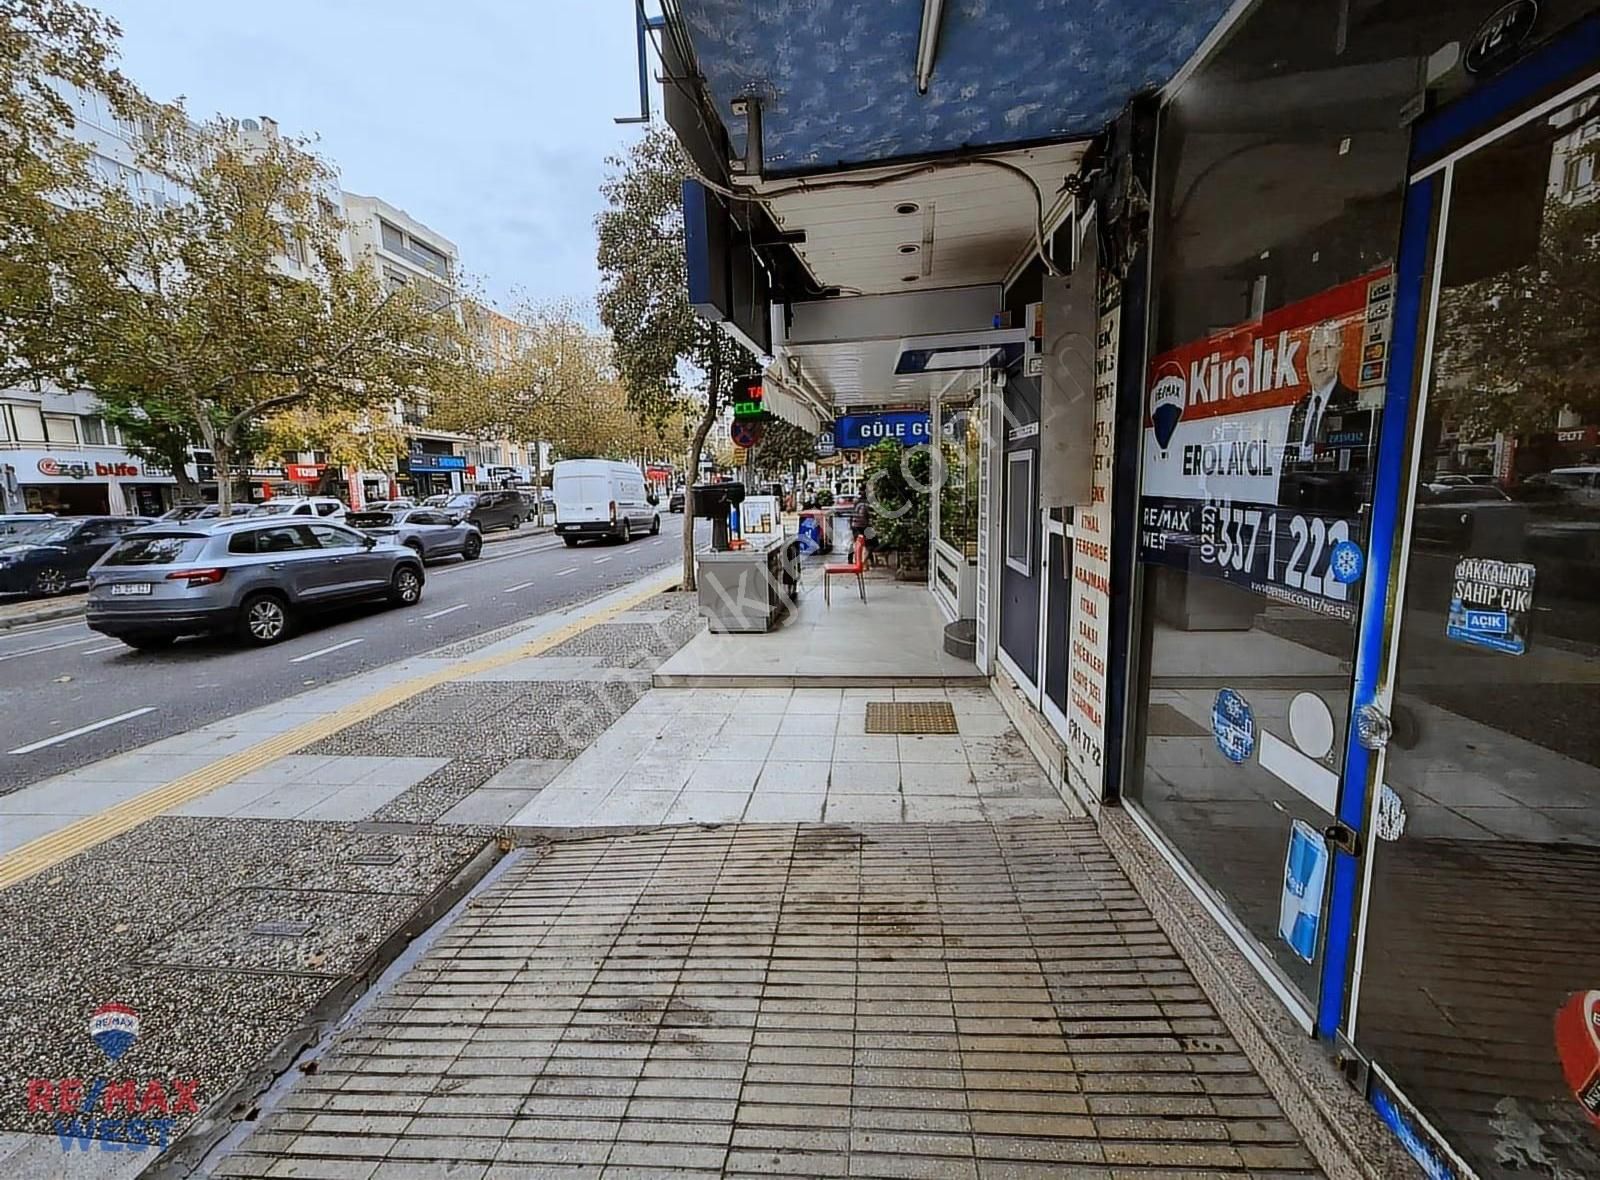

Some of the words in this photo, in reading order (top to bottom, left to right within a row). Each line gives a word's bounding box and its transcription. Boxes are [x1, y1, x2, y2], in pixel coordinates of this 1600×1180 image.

[1189, 331, 1301, 406] Kiralık
[860, 421, 905, 437] GÜLE
[912, 419, 932, 436] GÜ
[1183, 444, 1225, 476] EROL
[1143, 507, 1190, 532] RE/MAX
[1201, 505, 1217, 563] (0232)
[1218, 507, 1261, 574] 337
[1285, 514, 1350, 601] 222
[1456, 558, 1530, 587] BAKKALINA
[1455, 580, 1497, 606] SAHİP
[1470, 615, 1502, 629] AÇIK
